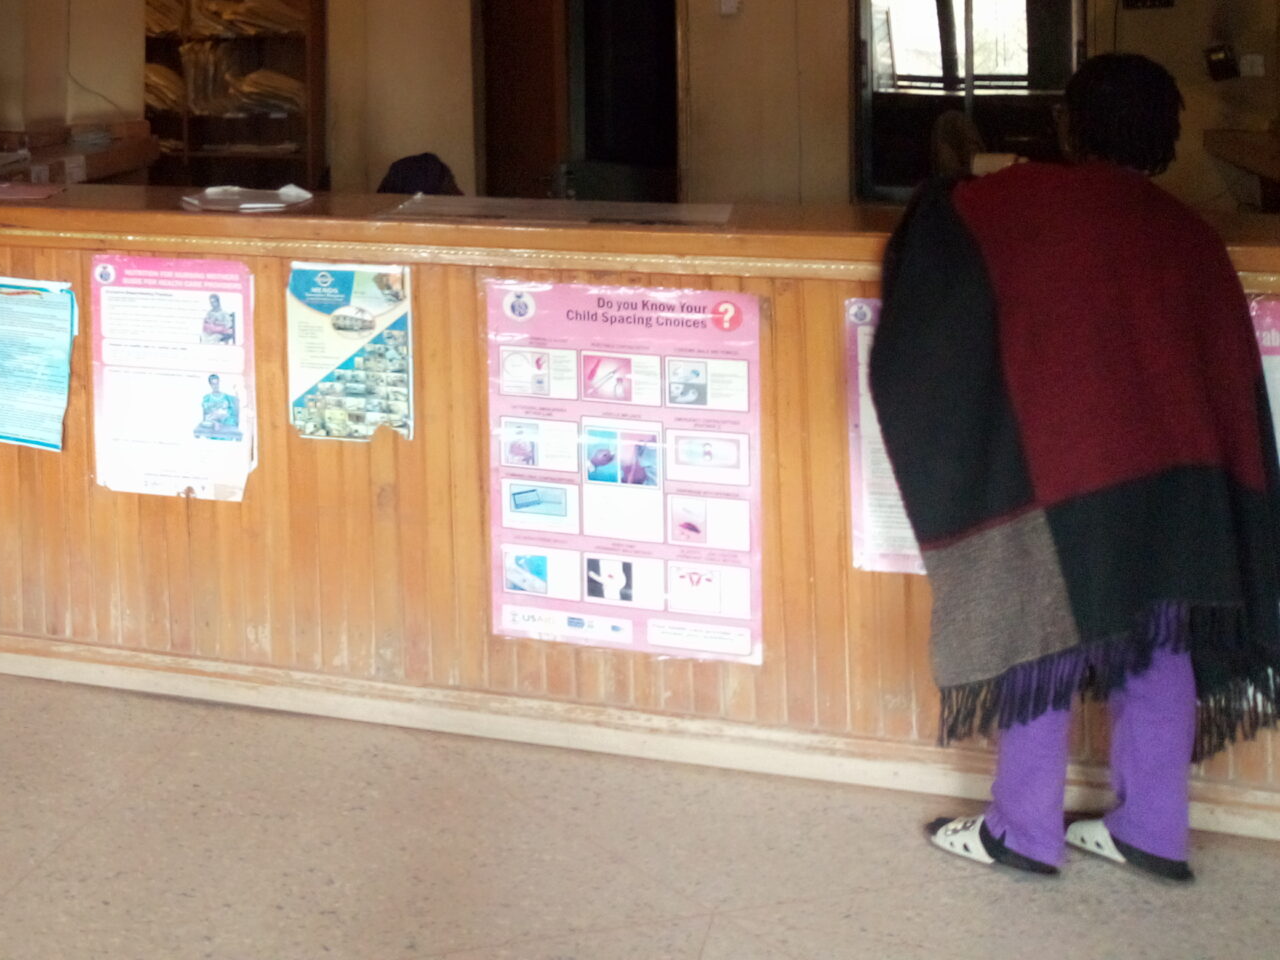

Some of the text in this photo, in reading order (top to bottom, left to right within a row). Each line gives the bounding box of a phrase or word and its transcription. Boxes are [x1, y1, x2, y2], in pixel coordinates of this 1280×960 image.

[597, 297, 613, 309] Do
[616, 300, 638, 313] you
[642, 300, 675, 313] Know
[679, 302, 708, 314] Your
[566, 309, 707, 329] Child Spacing Choices
